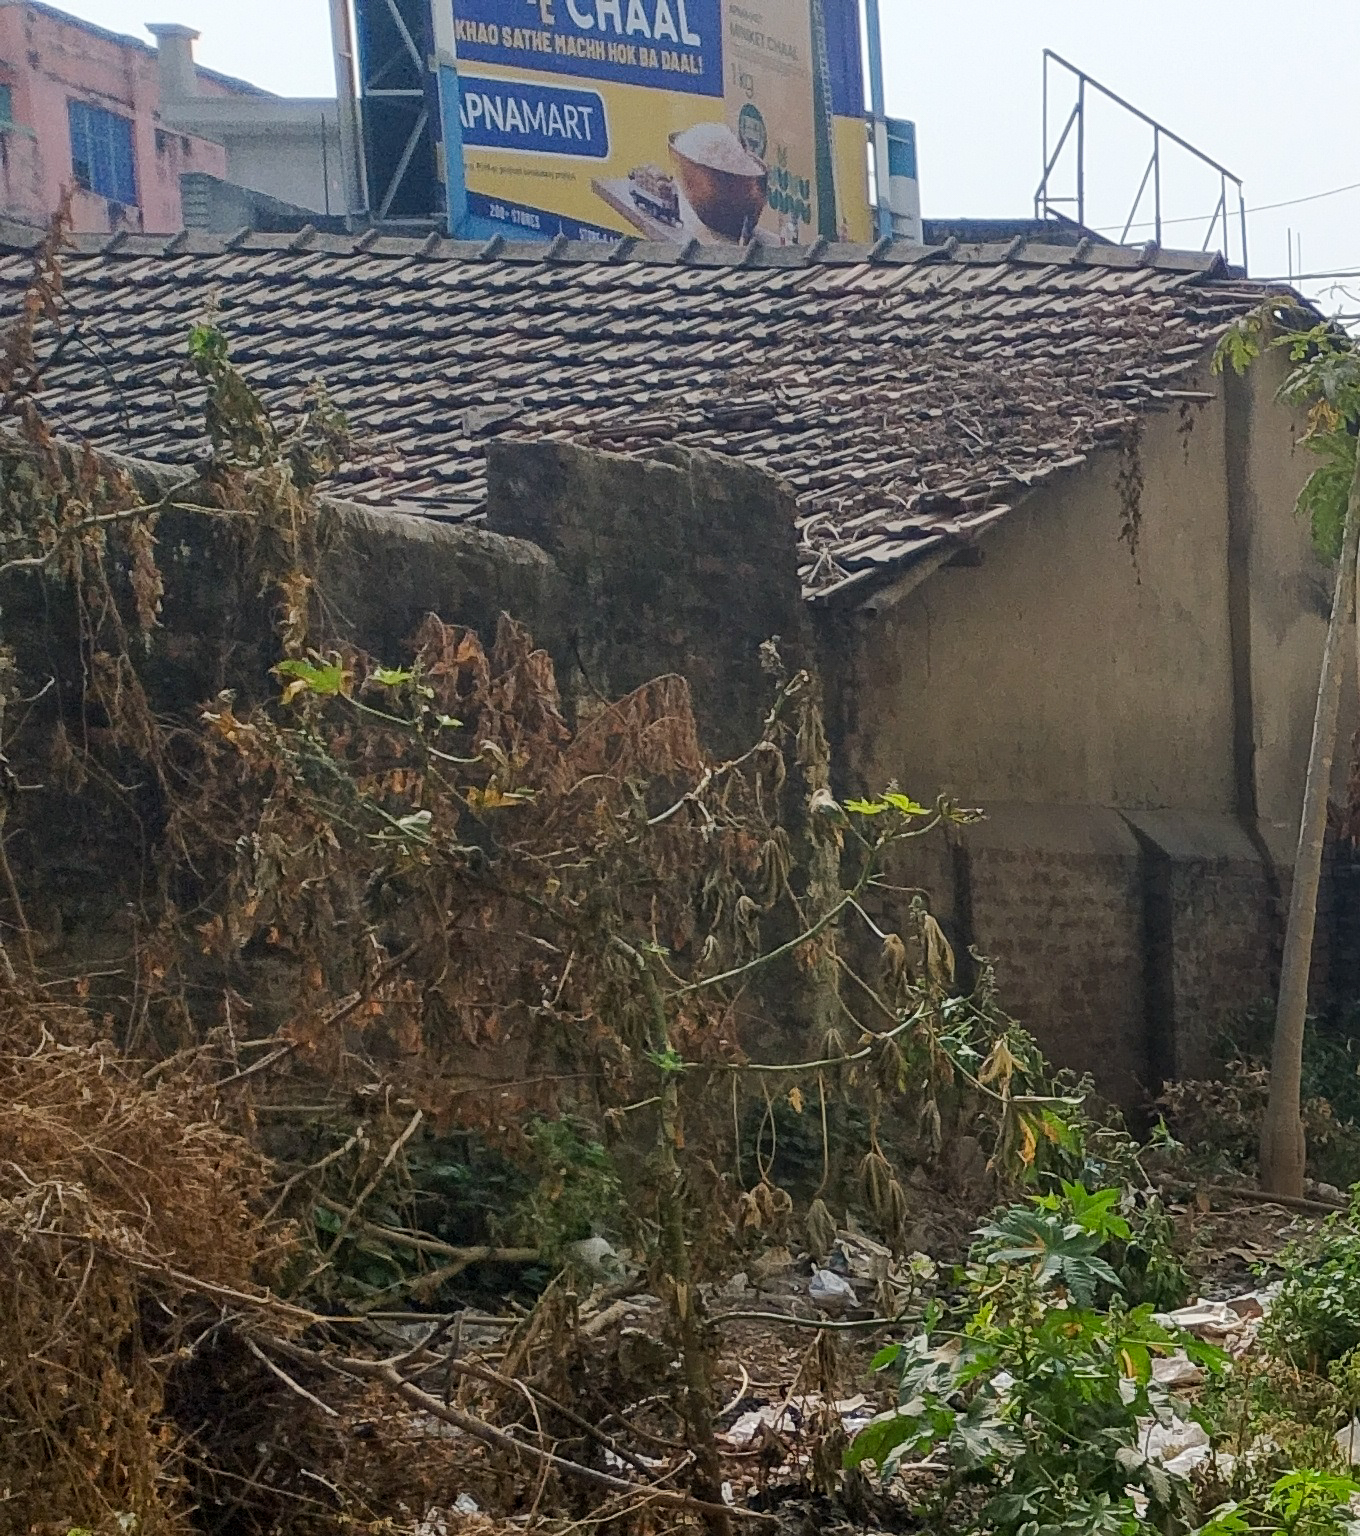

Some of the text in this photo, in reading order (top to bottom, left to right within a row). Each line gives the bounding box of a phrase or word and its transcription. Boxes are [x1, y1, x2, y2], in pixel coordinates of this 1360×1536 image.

[455, 19, 499, 46] KHAO
[502, 26, 551, 53] SATHE
[554, 35, 605, 61] MACHH
[607, 43, 637, 66] HOK
[639, 48, 660, 69] BA
[661, 50, 703, 76] DAAL!
[566, 0, 702, 47] CHAAL
